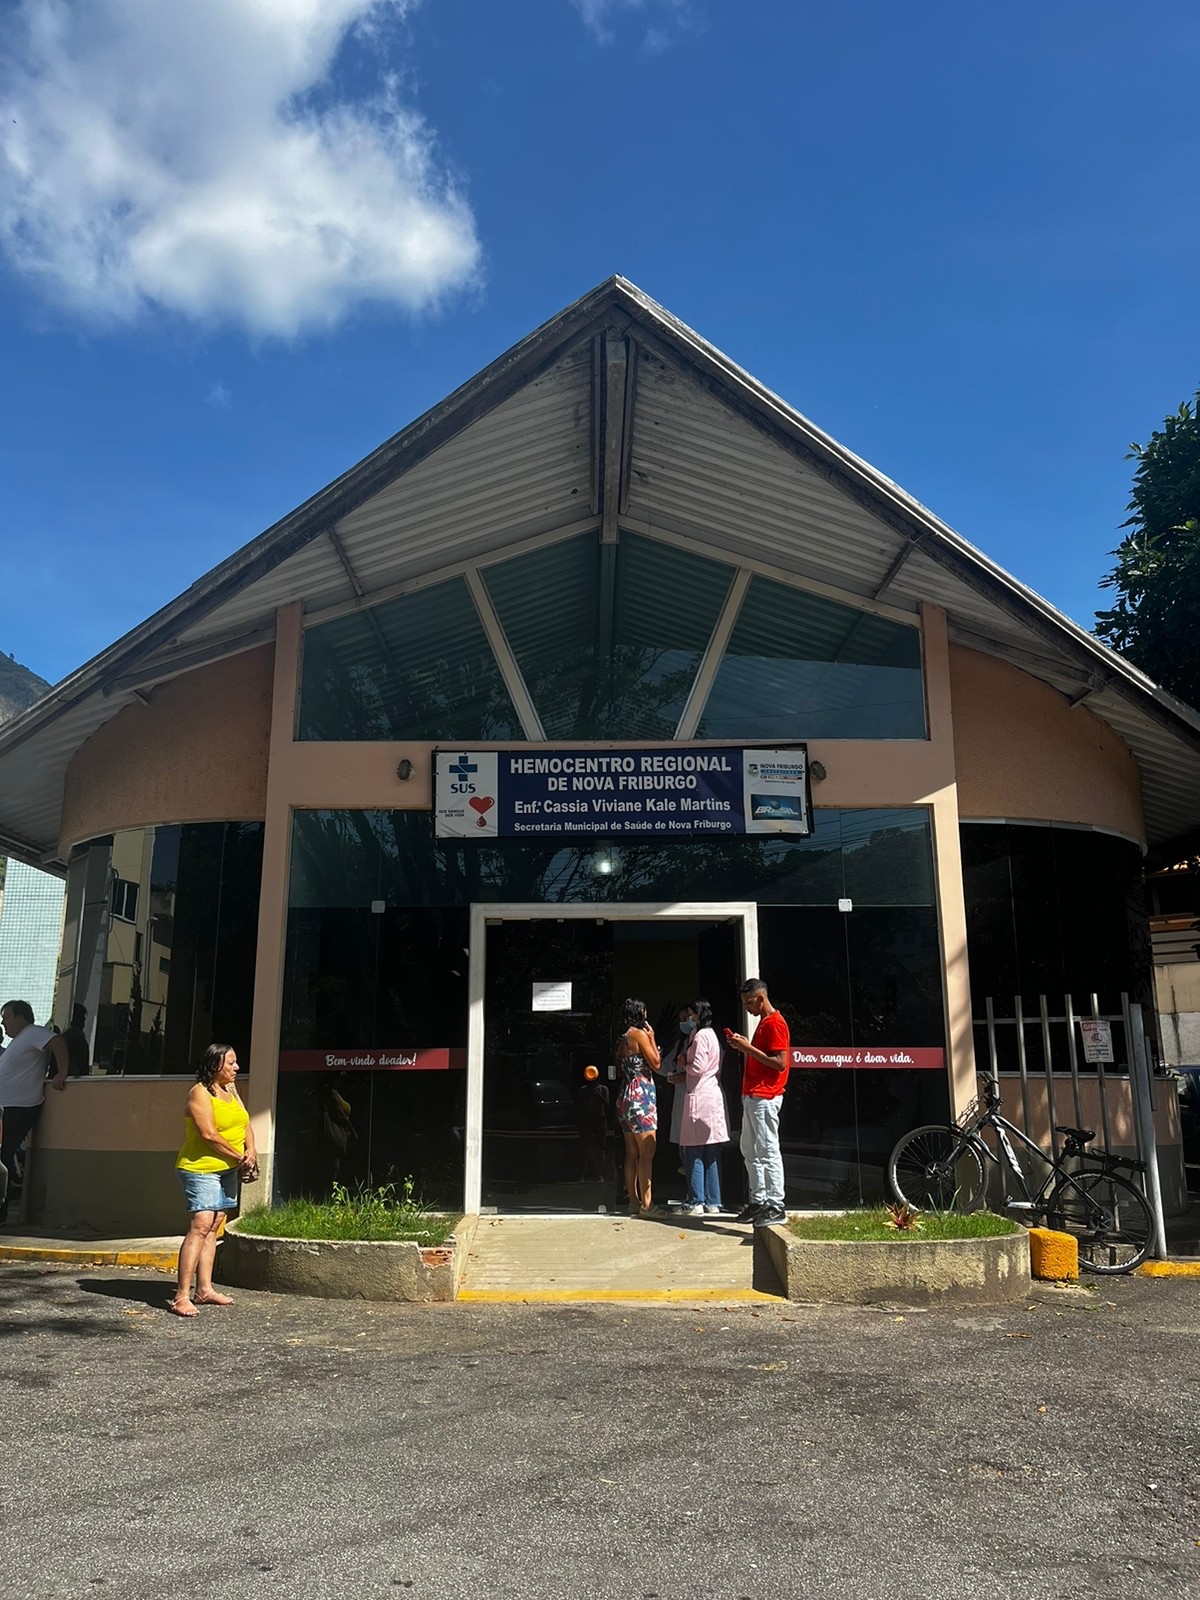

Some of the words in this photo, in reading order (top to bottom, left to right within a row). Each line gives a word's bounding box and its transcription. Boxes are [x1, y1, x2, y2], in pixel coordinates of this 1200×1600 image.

[510, 757, 635, 774] HEMOCENTRO
[640, 755, 732, 772] REGIONAL
[450, 783, 476, 794] SUS
[547, 777, 568, 791] DE
[572, 776, 615, 791] NOVA
[618, 774, 697, 790] FRIBURGO
[543, 799, 589, 813] Cassia
[592, 798, 643, 812] Viviane
[646, 798, 677, 812] Kale
[680, 797, 731, 811] Martins
[514, 822, 562, 832] Secretaria
[564, 821, 608, 832] Municipal
[610, 821, 622, 831] de
[624, 820, 653, 830] Saúde
[654, 820, 667, 830] de
[668, 820, 692, 830] Nova
[693, 819, 732, 831] Friburgo
[325, 1054, 375, 1067] Bem-vindo
[379, 1052, 417, 1067] doador!
[792, 1050, 817, 1064] Doar
[820, 1053, 853, 1068] sangue
[855, 1052, 862, 1064] é
[864, 1051, 888, 1064] doar
[889, 1051, 915, 1065] vida.
